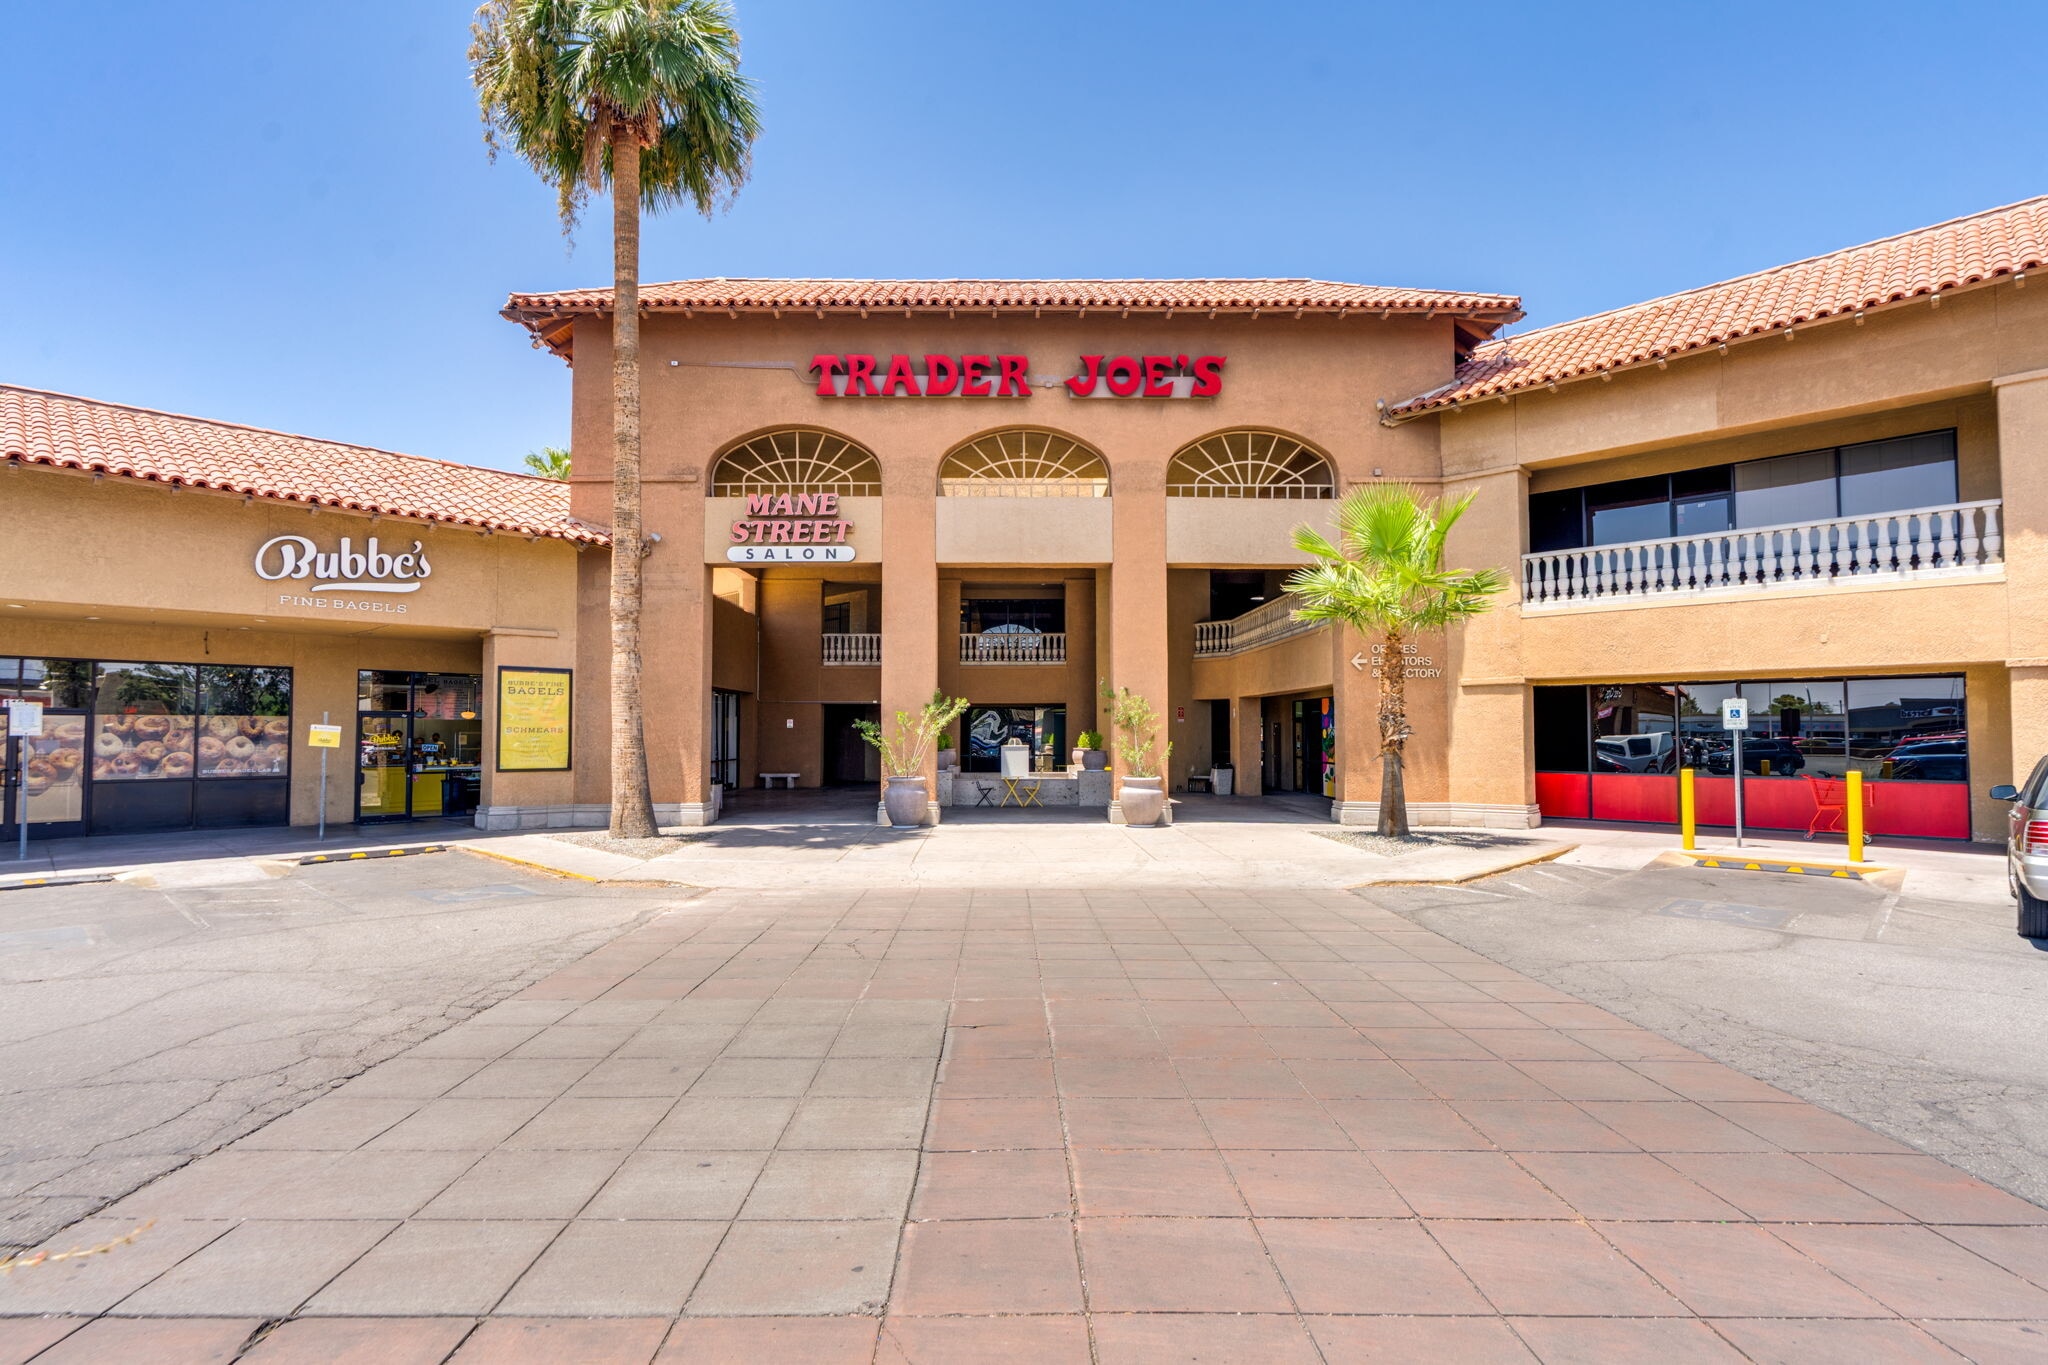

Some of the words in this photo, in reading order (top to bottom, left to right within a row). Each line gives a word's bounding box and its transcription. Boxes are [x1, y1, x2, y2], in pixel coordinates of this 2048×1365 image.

[808, 353, 1033, 397] TRADER
[1064, 353, 1228, 397] JOE'S
[744, 492, 840, 516] MANE
[729, 520, 854, 543] STREET
[255, 535, 432, 580] Bubbe's
[745, 548, 838, 560] SALON
[280, 595, 327, 608] FINE
[333, 600, 408, 614] BAGELS
[507, 686, 565, 696] BAGELS
[506, 726, 564, 734] SCHMEARS
